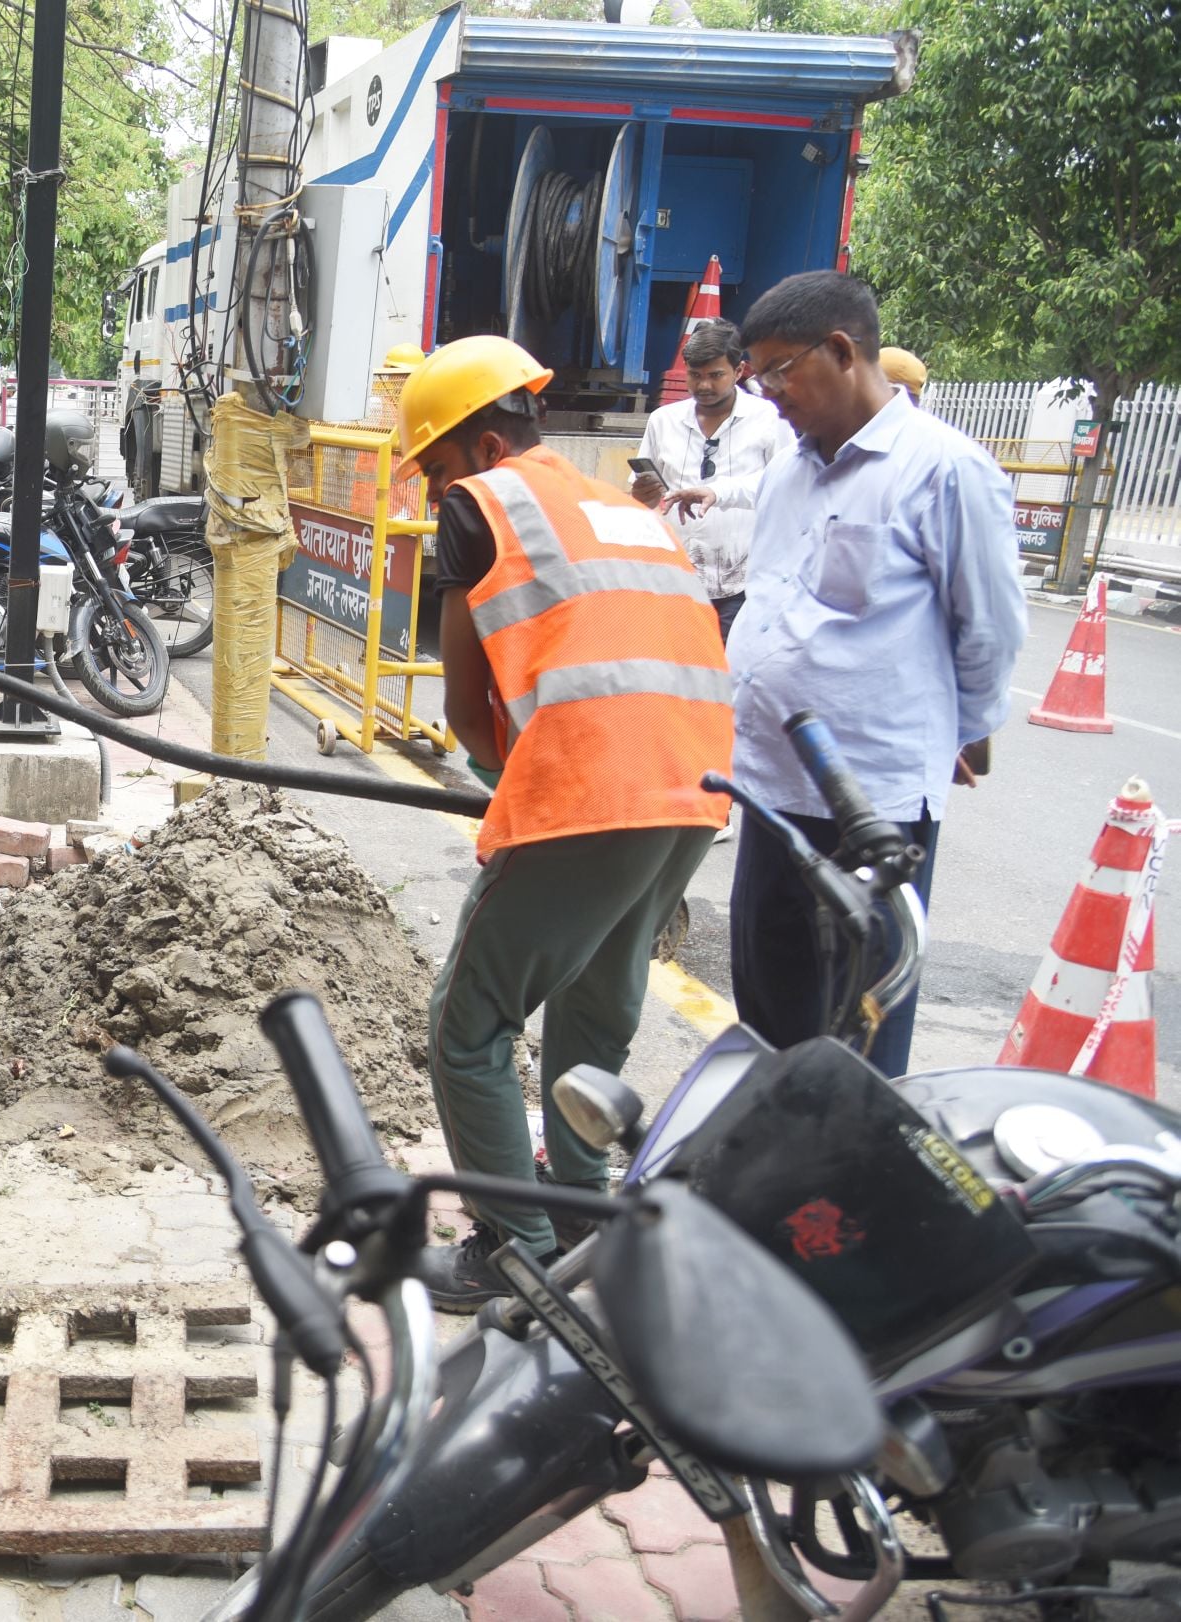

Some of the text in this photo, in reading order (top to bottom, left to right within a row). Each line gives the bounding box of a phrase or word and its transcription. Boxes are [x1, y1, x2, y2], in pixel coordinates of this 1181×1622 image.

[368, 90, 382, 115] TPS
[301, 520, 349, 566] यातायात
[307, 570, 369, 620] जनपद-लखन
